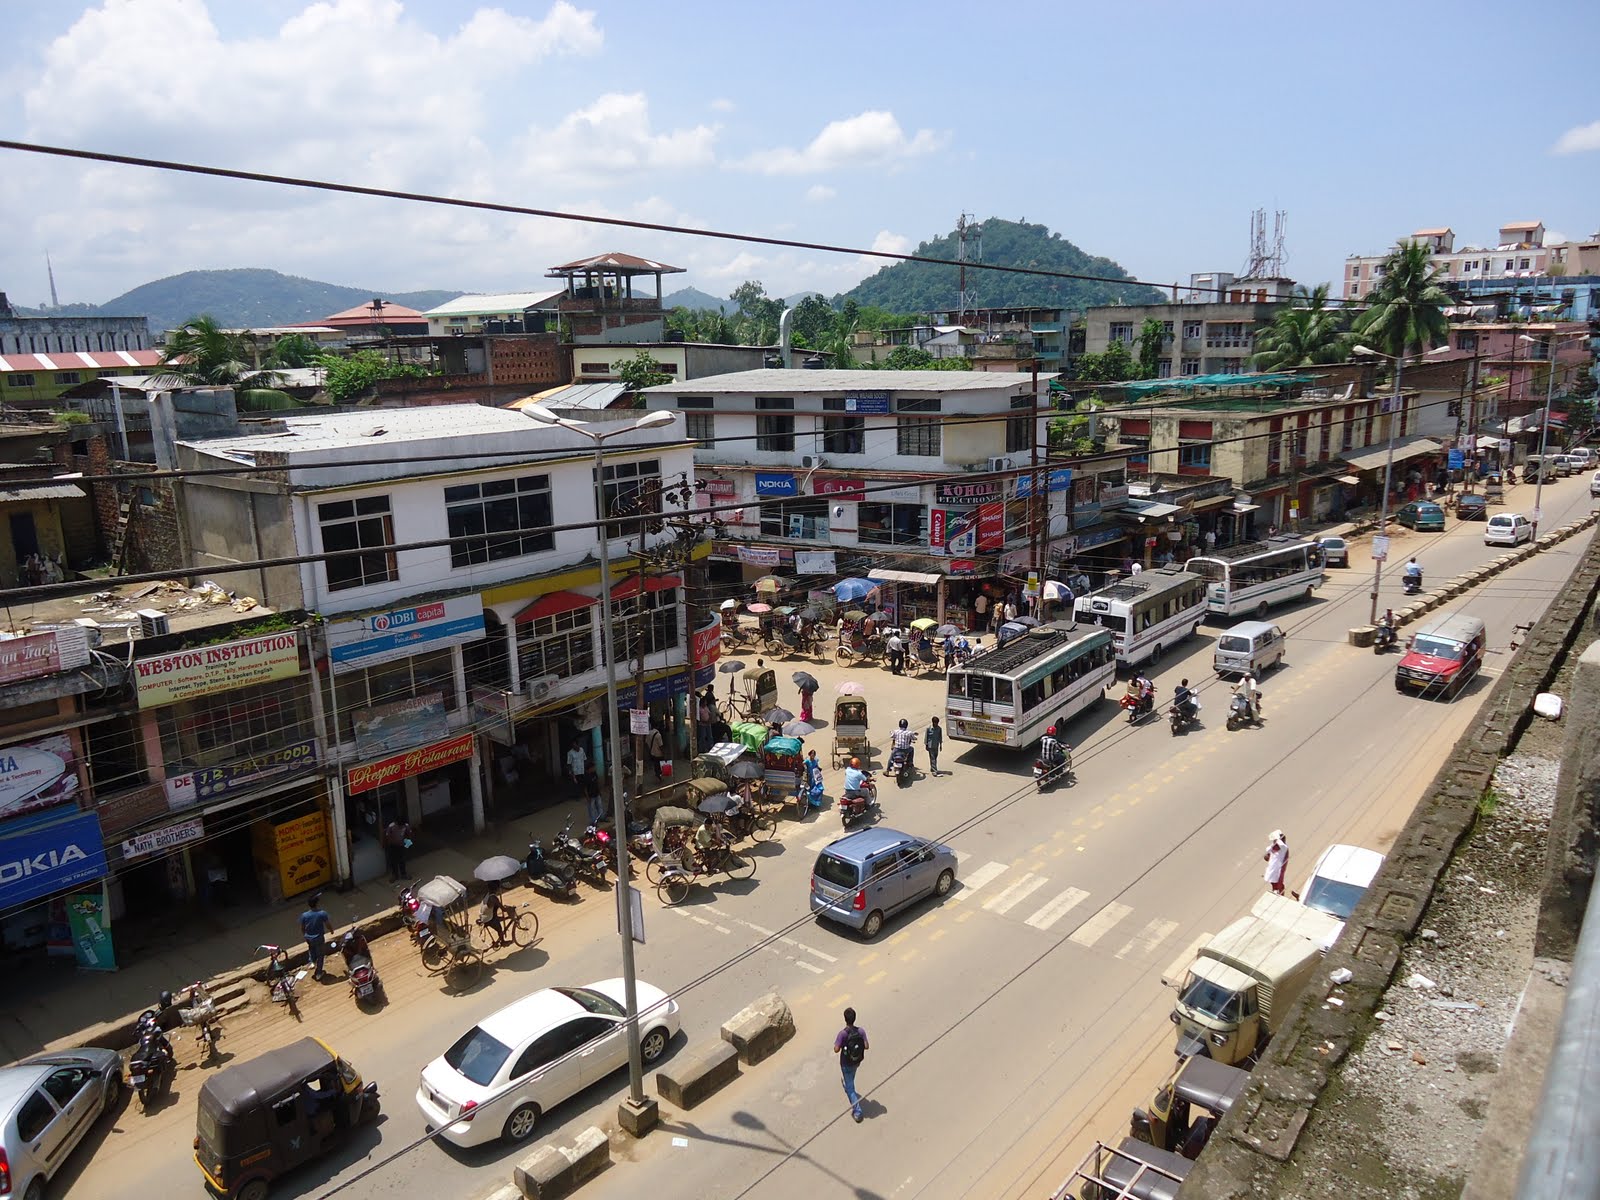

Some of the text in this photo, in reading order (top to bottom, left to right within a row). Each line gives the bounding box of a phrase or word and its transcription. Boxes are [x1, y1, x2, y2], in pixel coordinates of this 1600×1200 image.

[759, 480, 792, 488] NOKIA
[391, 605, 444, 625] IDBI capital
[22, 640, 58, 660] Track
[136, 635, 296, 677] WESTON INSTITUTION
[138, 679, 173, 692] COMPUTER
[238, 662, 263, 672] Hardware
[269, 655, 298, 666] Networking
[205, 660, 237, 671] Training for
[209, 677, 226, 685] Steno
[232, 671, 253, 680] Spoken
[253, 667, 273, 676] English
[180, 688, 206, 698] Complete
[207, 683, 231, 692] Solution
[244, 675, 271, 684] Education
[274, 745, 311, 762] FOOD
[404, 740, 472, 771] Restaurant
[11, 768, 42, 780] Technology
[174, 776, 195, 789] DE
[134, 841, 153, 854] NATH
[156, 827, 197, 846] BROTHERS
[0, 844, 89, 884] OKIA
